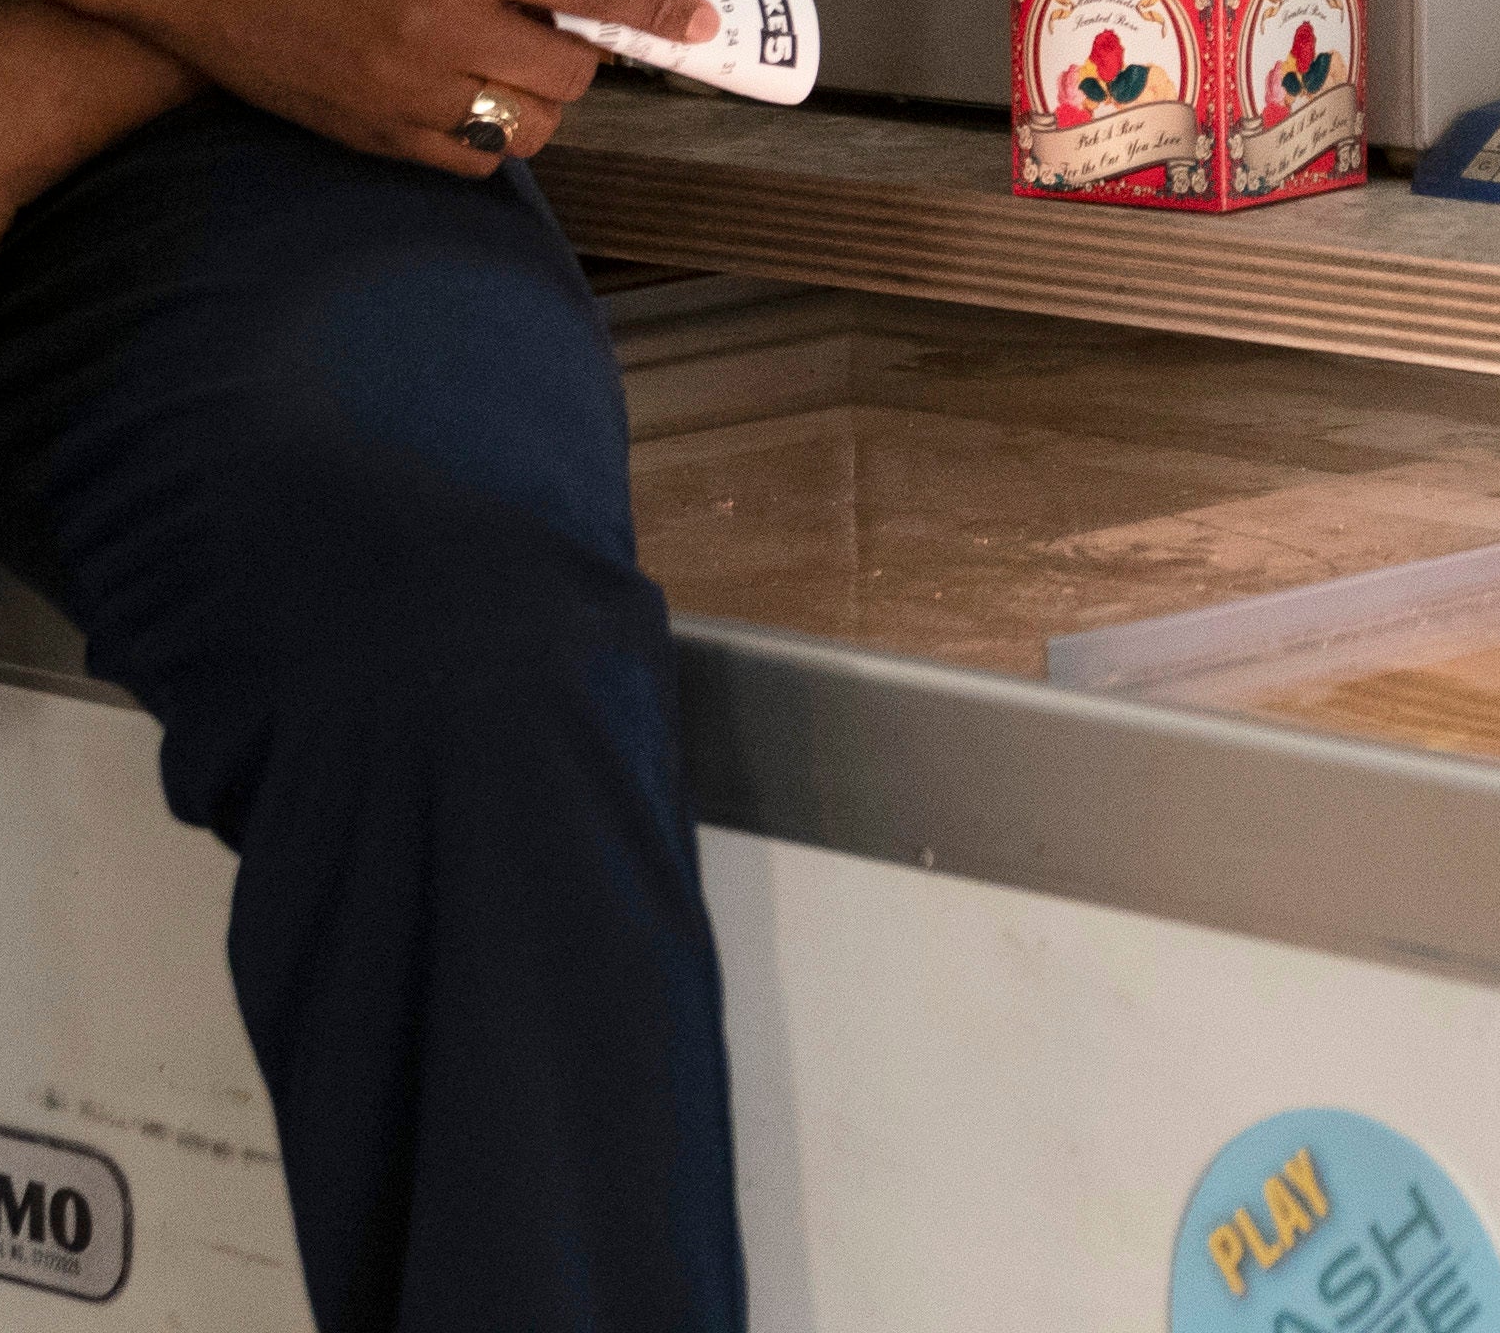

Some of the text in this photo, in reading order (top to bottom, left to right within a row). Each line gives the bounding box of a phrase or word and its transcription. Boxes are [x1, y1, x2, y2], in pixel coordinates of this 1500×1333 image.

[1115, 12, 1140, 32] Rose
[1076, 118, 1146, 150] Pick A Rose
[1079, 154, 1097, 175] the
[1100, 144, 1122, 166] One
[1125, 137, 1150, 162] You
[1154, 132, 1183, 150] Love
[1207, 1145, 1332, 1297] PLAY
